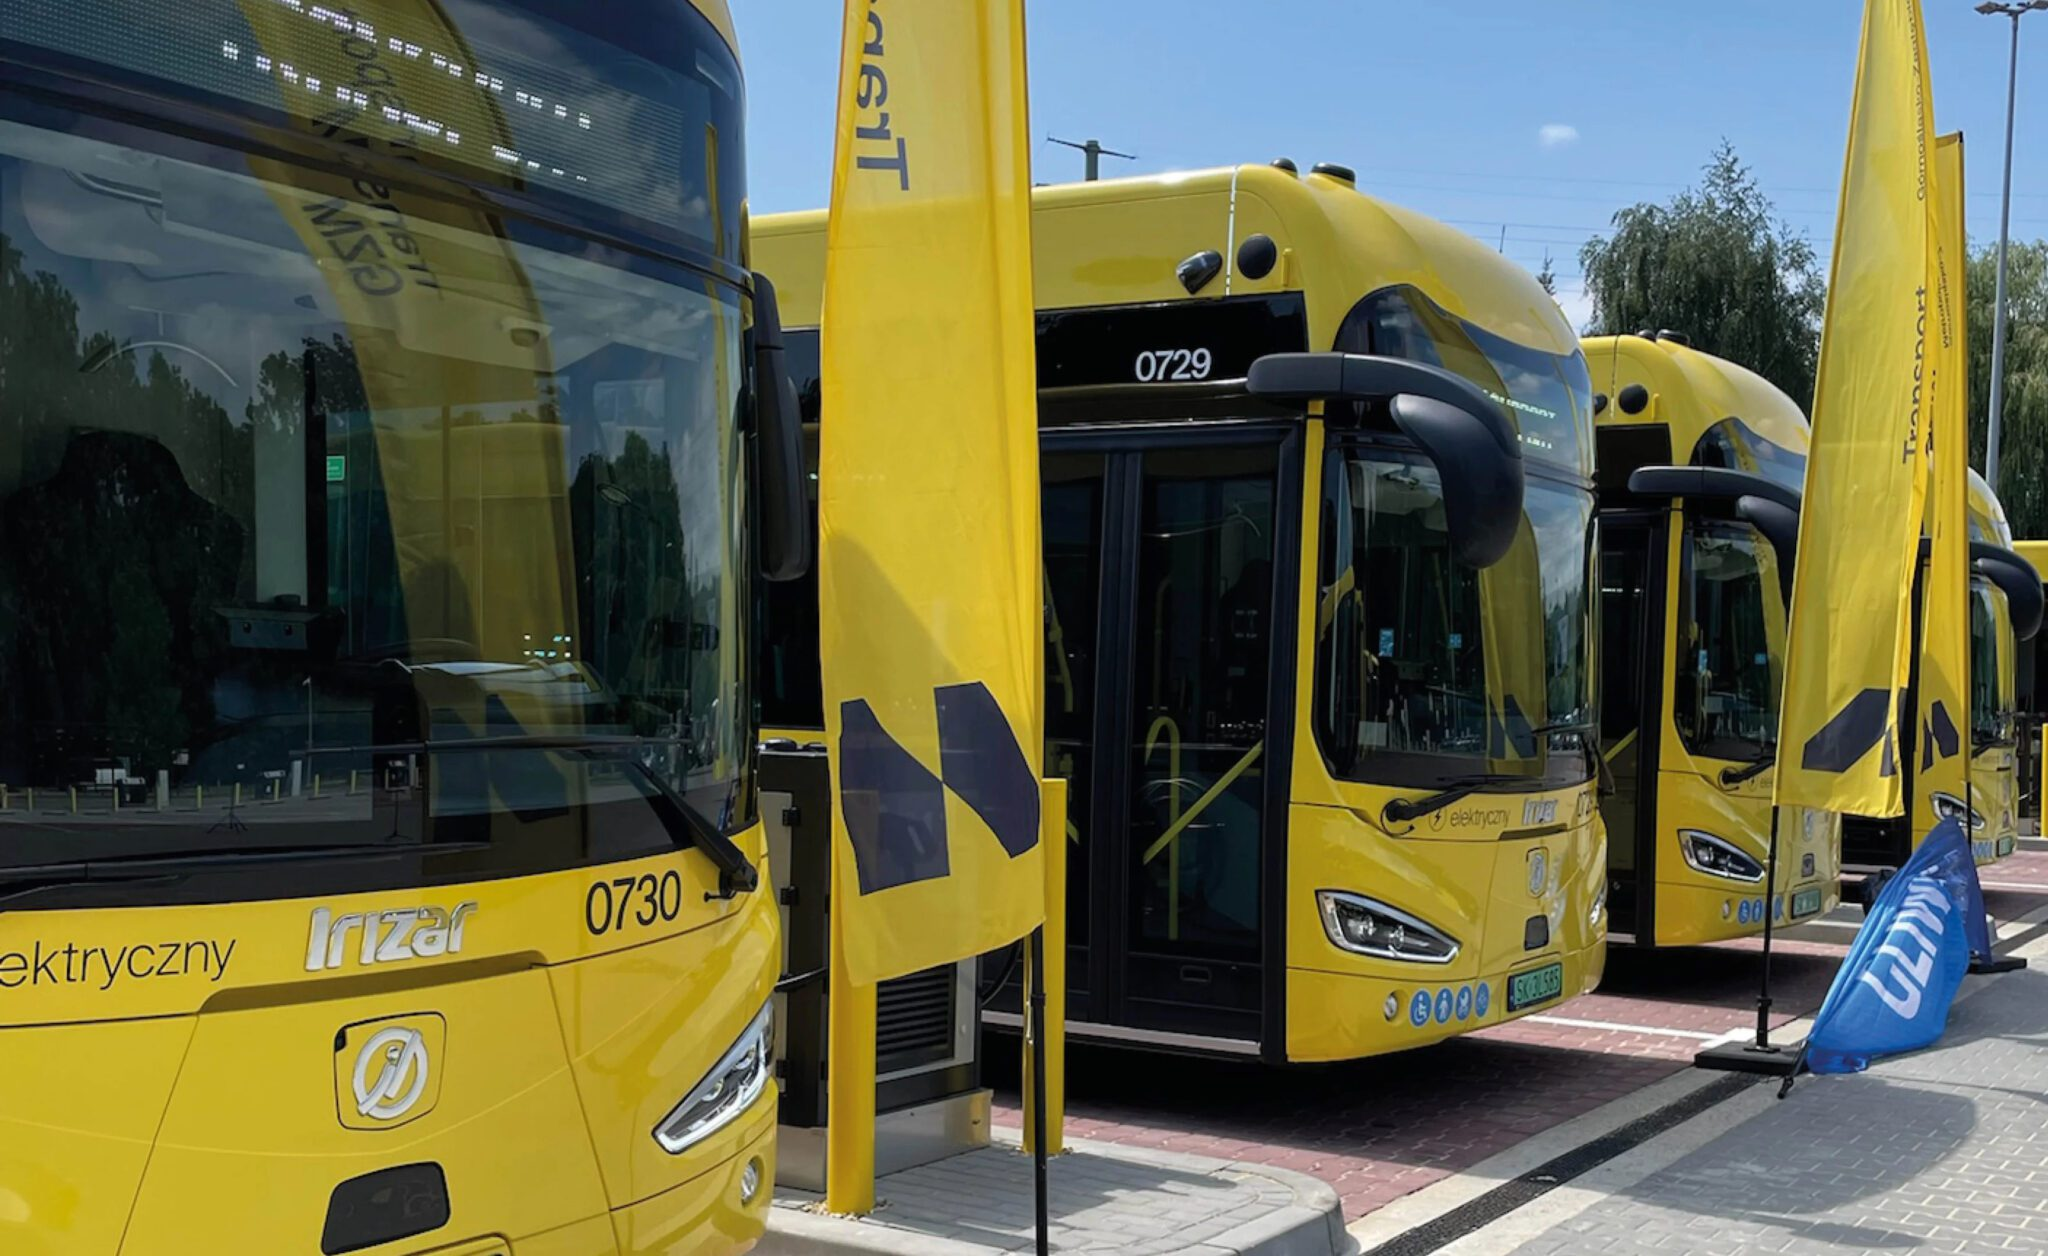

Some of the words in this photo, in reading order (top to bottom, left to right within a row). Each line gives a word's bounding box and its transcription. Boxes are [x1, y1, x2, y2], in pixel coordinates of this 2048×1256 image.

[1135, 347, 1212, 382] 0729
[1450, 809, 1511, 830] elektryczny
[586, 870, 682, 936] 0730
[304, 902, 478, 972] Irizar
